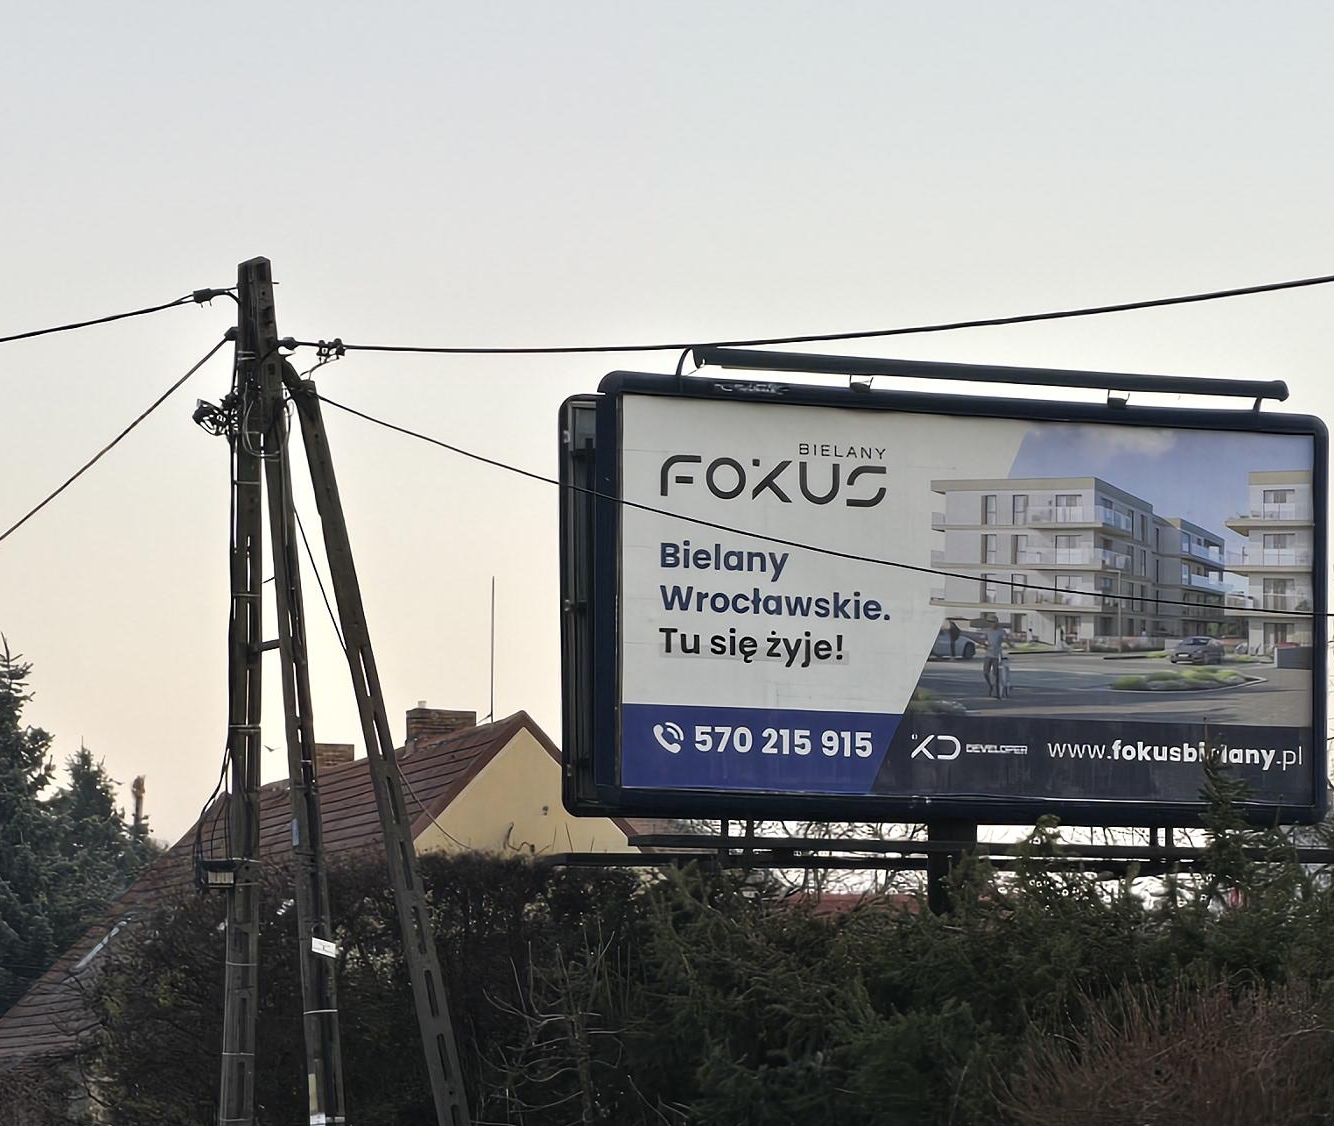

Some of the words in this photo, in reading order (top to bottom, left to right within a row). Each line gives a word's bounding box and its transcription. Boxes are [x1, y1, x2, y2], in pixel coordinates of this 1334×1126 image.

[798, 443, 887, 460] BIELANY
[660, 454, 887, 508] FOKUS
[660, 540, 789, 582] Bielany
[660, 585, 891, 621] Wrocławskie.
[659, 628, 700, 654] Tu
[710, 628, 758, 663] się
[766, 630, 844, 668] żyje!
[694, 725, 753, 753] 570
[761, 728, 812, 756] 215
[821, 730, 873, 757] 915
[966, 743, 1028, 755] DEVELOPER
[1047, 739, 1303, 771] www.fokusbilany.pl
